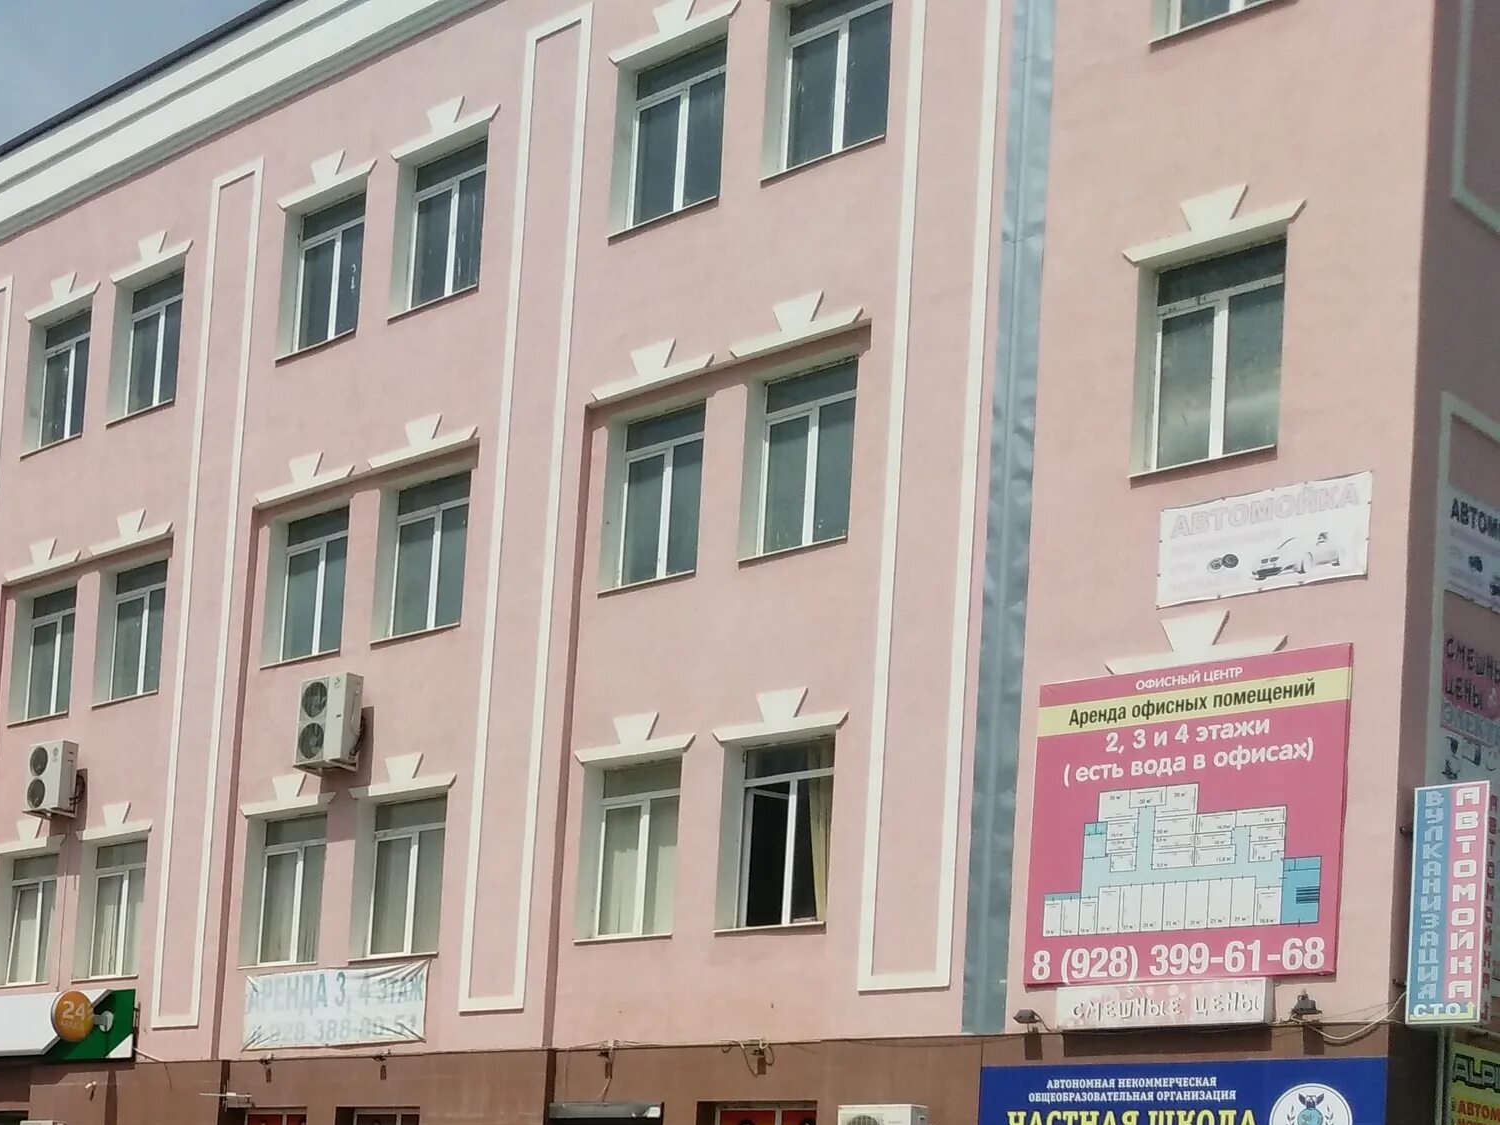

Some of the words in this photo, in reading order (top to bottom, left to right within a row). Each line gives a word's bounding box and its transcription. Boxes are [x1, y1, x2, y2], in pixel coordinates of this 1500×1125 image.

[1135, 671, 1201, 691] ОФИСНЫЙ
[1203, 666, 1243, 684] ЦЕНТР
[1069, 704, 1127, 728] Аренда
[1131, 693, 1208, 720] офисных
[1213, 678, 1315, 708] помещений
[1105, 732, 1125, 754] 2,
[1132, 729, 1146, 749] 3
[1153, 731, 1167, 747] и
[1174, 724, 1189, 744] 4
[1196, 718, 1270, 743] этажи
[1131, 756, 1186, 777] вода
[1193, 755, 1206, 769] в
[1213, 737, 1314, 770] офисах)
[1448, 787, 1480, 999] АВТОМОЙКА
[1031, 950, 1050, 980] 8
[1061, 945, 1138, 984] (928)
[1150, 937, 1325, 976] 399-61-68
[62, 1000, 85, 1021] 24
[246, 973, 329, 1016] АРЕНДА
[1072, 994, 1183, 1022] СМЕШНЫЕ
[1196, 991, 1261, 1016] ЦЕНЫ
[1413, 1002, 1460, 1018] СТО
[1028, 1090, 1154, 1103] ОБЩЕОБРАЗОВАТЕЛЬНАЯ
[1156, 1089, 1236, 1102] ОРГАНИЗАЦИЯ
[1046, 1079, 1115, 1090] АВТОНОМНАЯ
[1118, 1076, 1217, 1088] НЕКОММЕРЧЕСКАЯ
